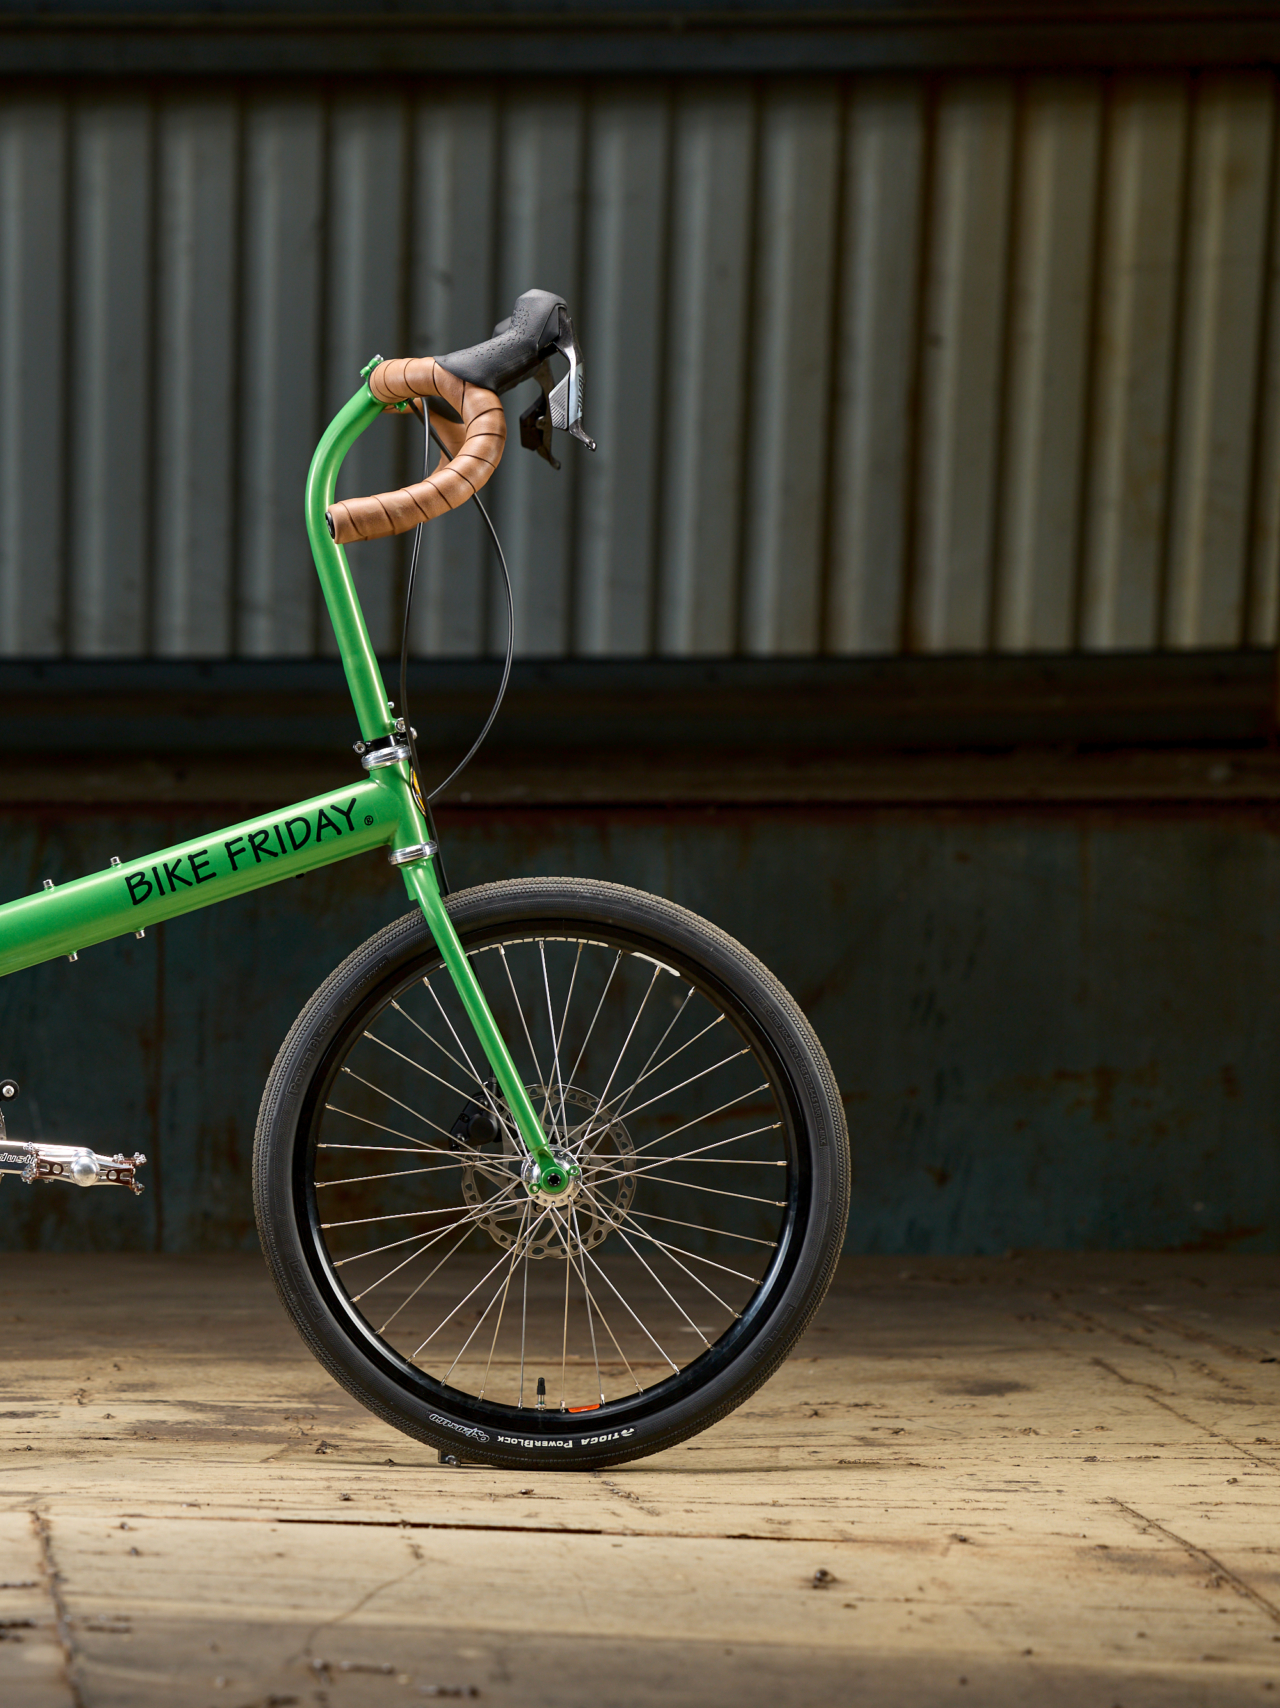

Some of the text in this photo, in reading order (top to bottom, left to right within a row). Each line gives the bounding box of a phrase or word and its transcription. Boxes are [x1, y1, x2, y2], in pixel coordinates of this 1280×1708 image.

[125, 798, 357, 905] BIKE FRIDAY
[581, 1433, 620, 1446] TIOGA
